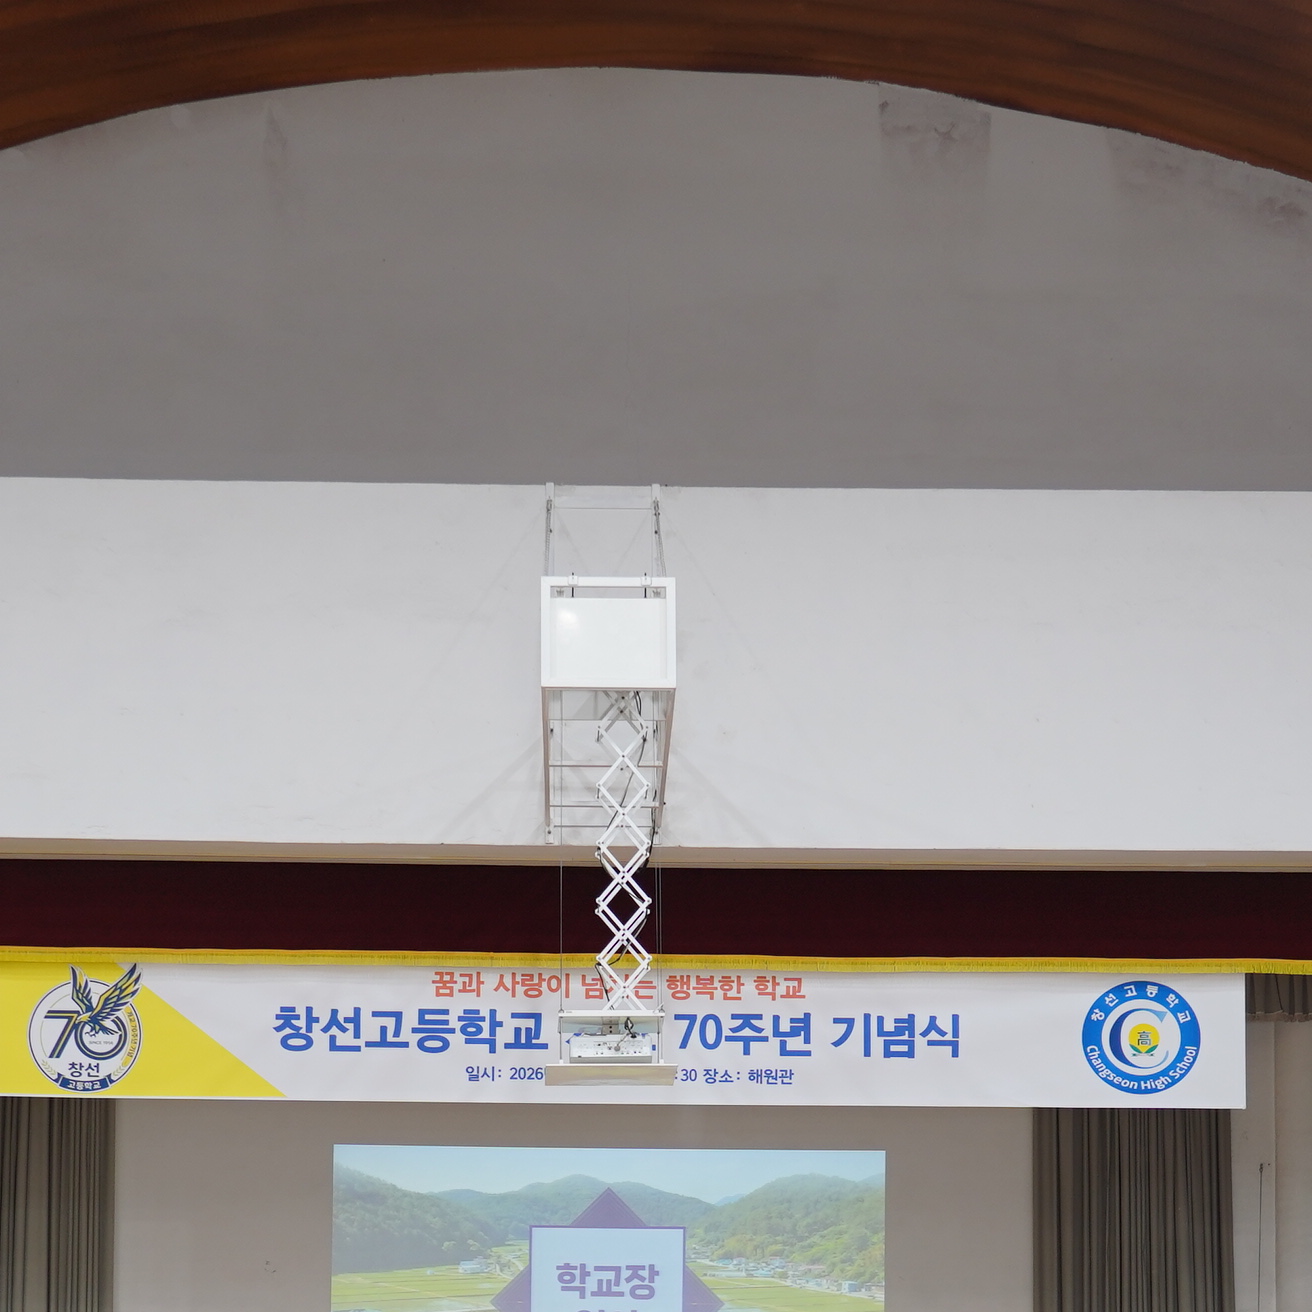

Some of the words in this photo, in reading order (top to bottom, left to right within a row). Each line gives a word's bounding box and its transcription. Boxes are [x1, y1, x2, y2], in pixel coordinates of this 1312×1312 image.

[431, 970, 485, 998] 꿈과
[493, 972, 571, 999] 사랑이
[581, 974, 657, 1000] 넘는
[666, 974, 745, 1001] 행복한
[753, 975, 806, 1001] 학교
[1090, 984, 1192, 1024] 창선고등학교
[271, 1005, 549, 1054] 창선고등학교
[673, 1011, 812, 1057] 70주년
[830, 1011, 961, 1060] 기념식
[68, 1062, 100, 1078] 창선
[465, 1065, 502, 1082] 일시:
[702, 1067, 741, 1085] 장소:
[747, 1068, 794, 1085] 해원관
[1086, 1044, 1139, 1090] Changseon
[1140, 1075, 1172, 1091] High
[1168, 1046, 1198, 1080] School
[67, 1081, 102, 1091] 고등학교
[554, 1262, 660, 1302] 학교장
